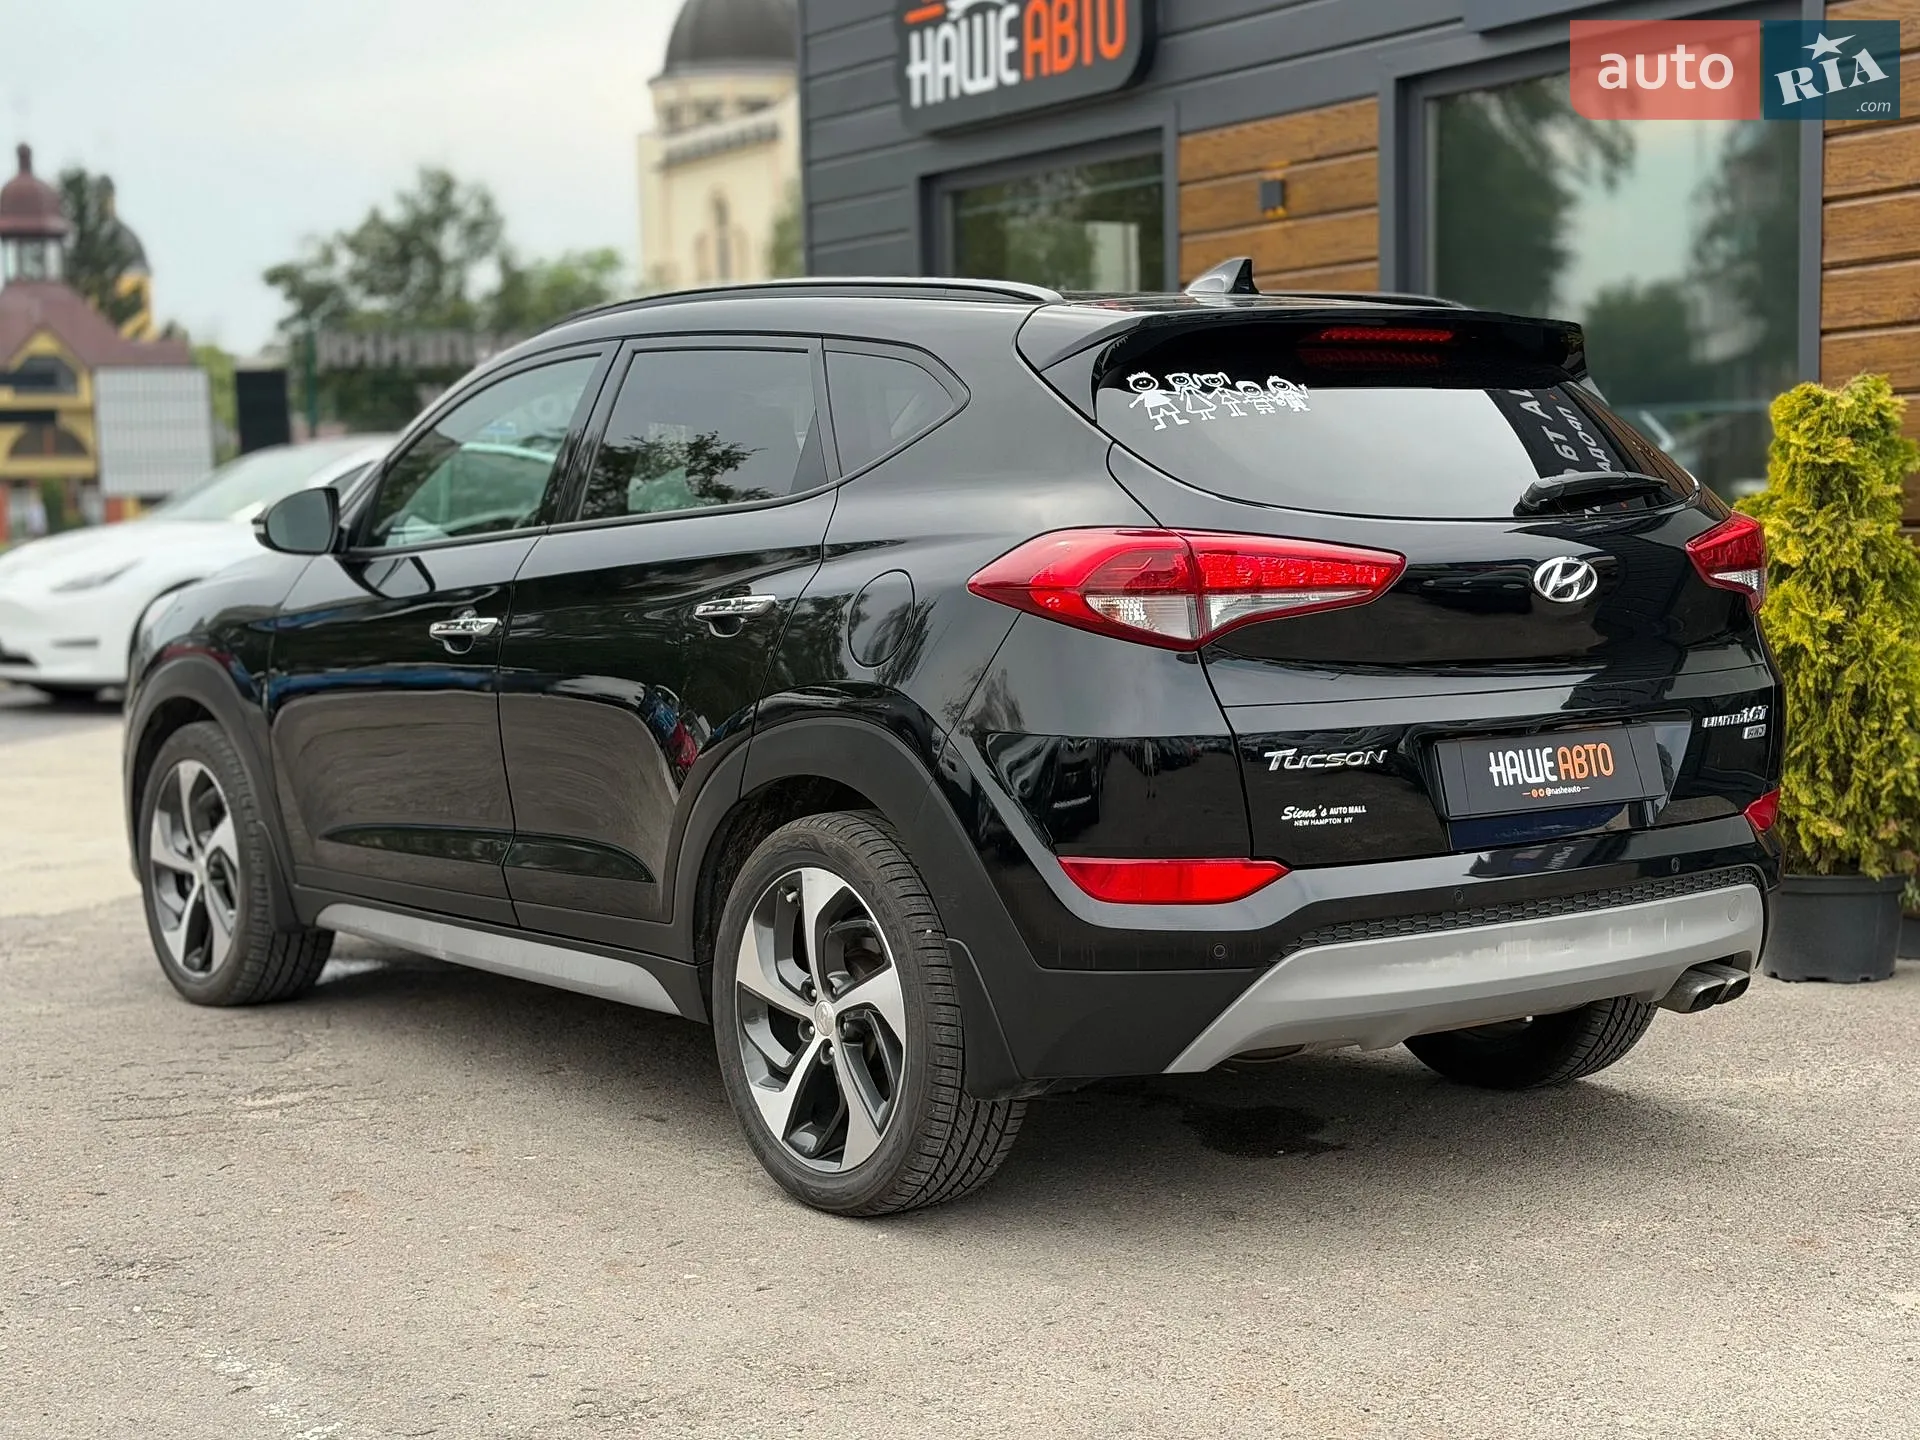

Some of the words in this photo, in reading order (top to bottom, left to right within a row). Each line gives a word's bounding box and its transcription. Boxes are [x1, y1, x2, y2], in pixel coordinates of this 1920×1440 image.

[1280, 804, 1328, 821] Siena's
[1329, 806, 1348, 816] AUTO
[1348, 805, 1367, 814] MALL
[1293, 819, 1310, 827] NEW
[1310, 817, 1342, 826] HAMPTON
[1344, 816, 1354, 824] NY
